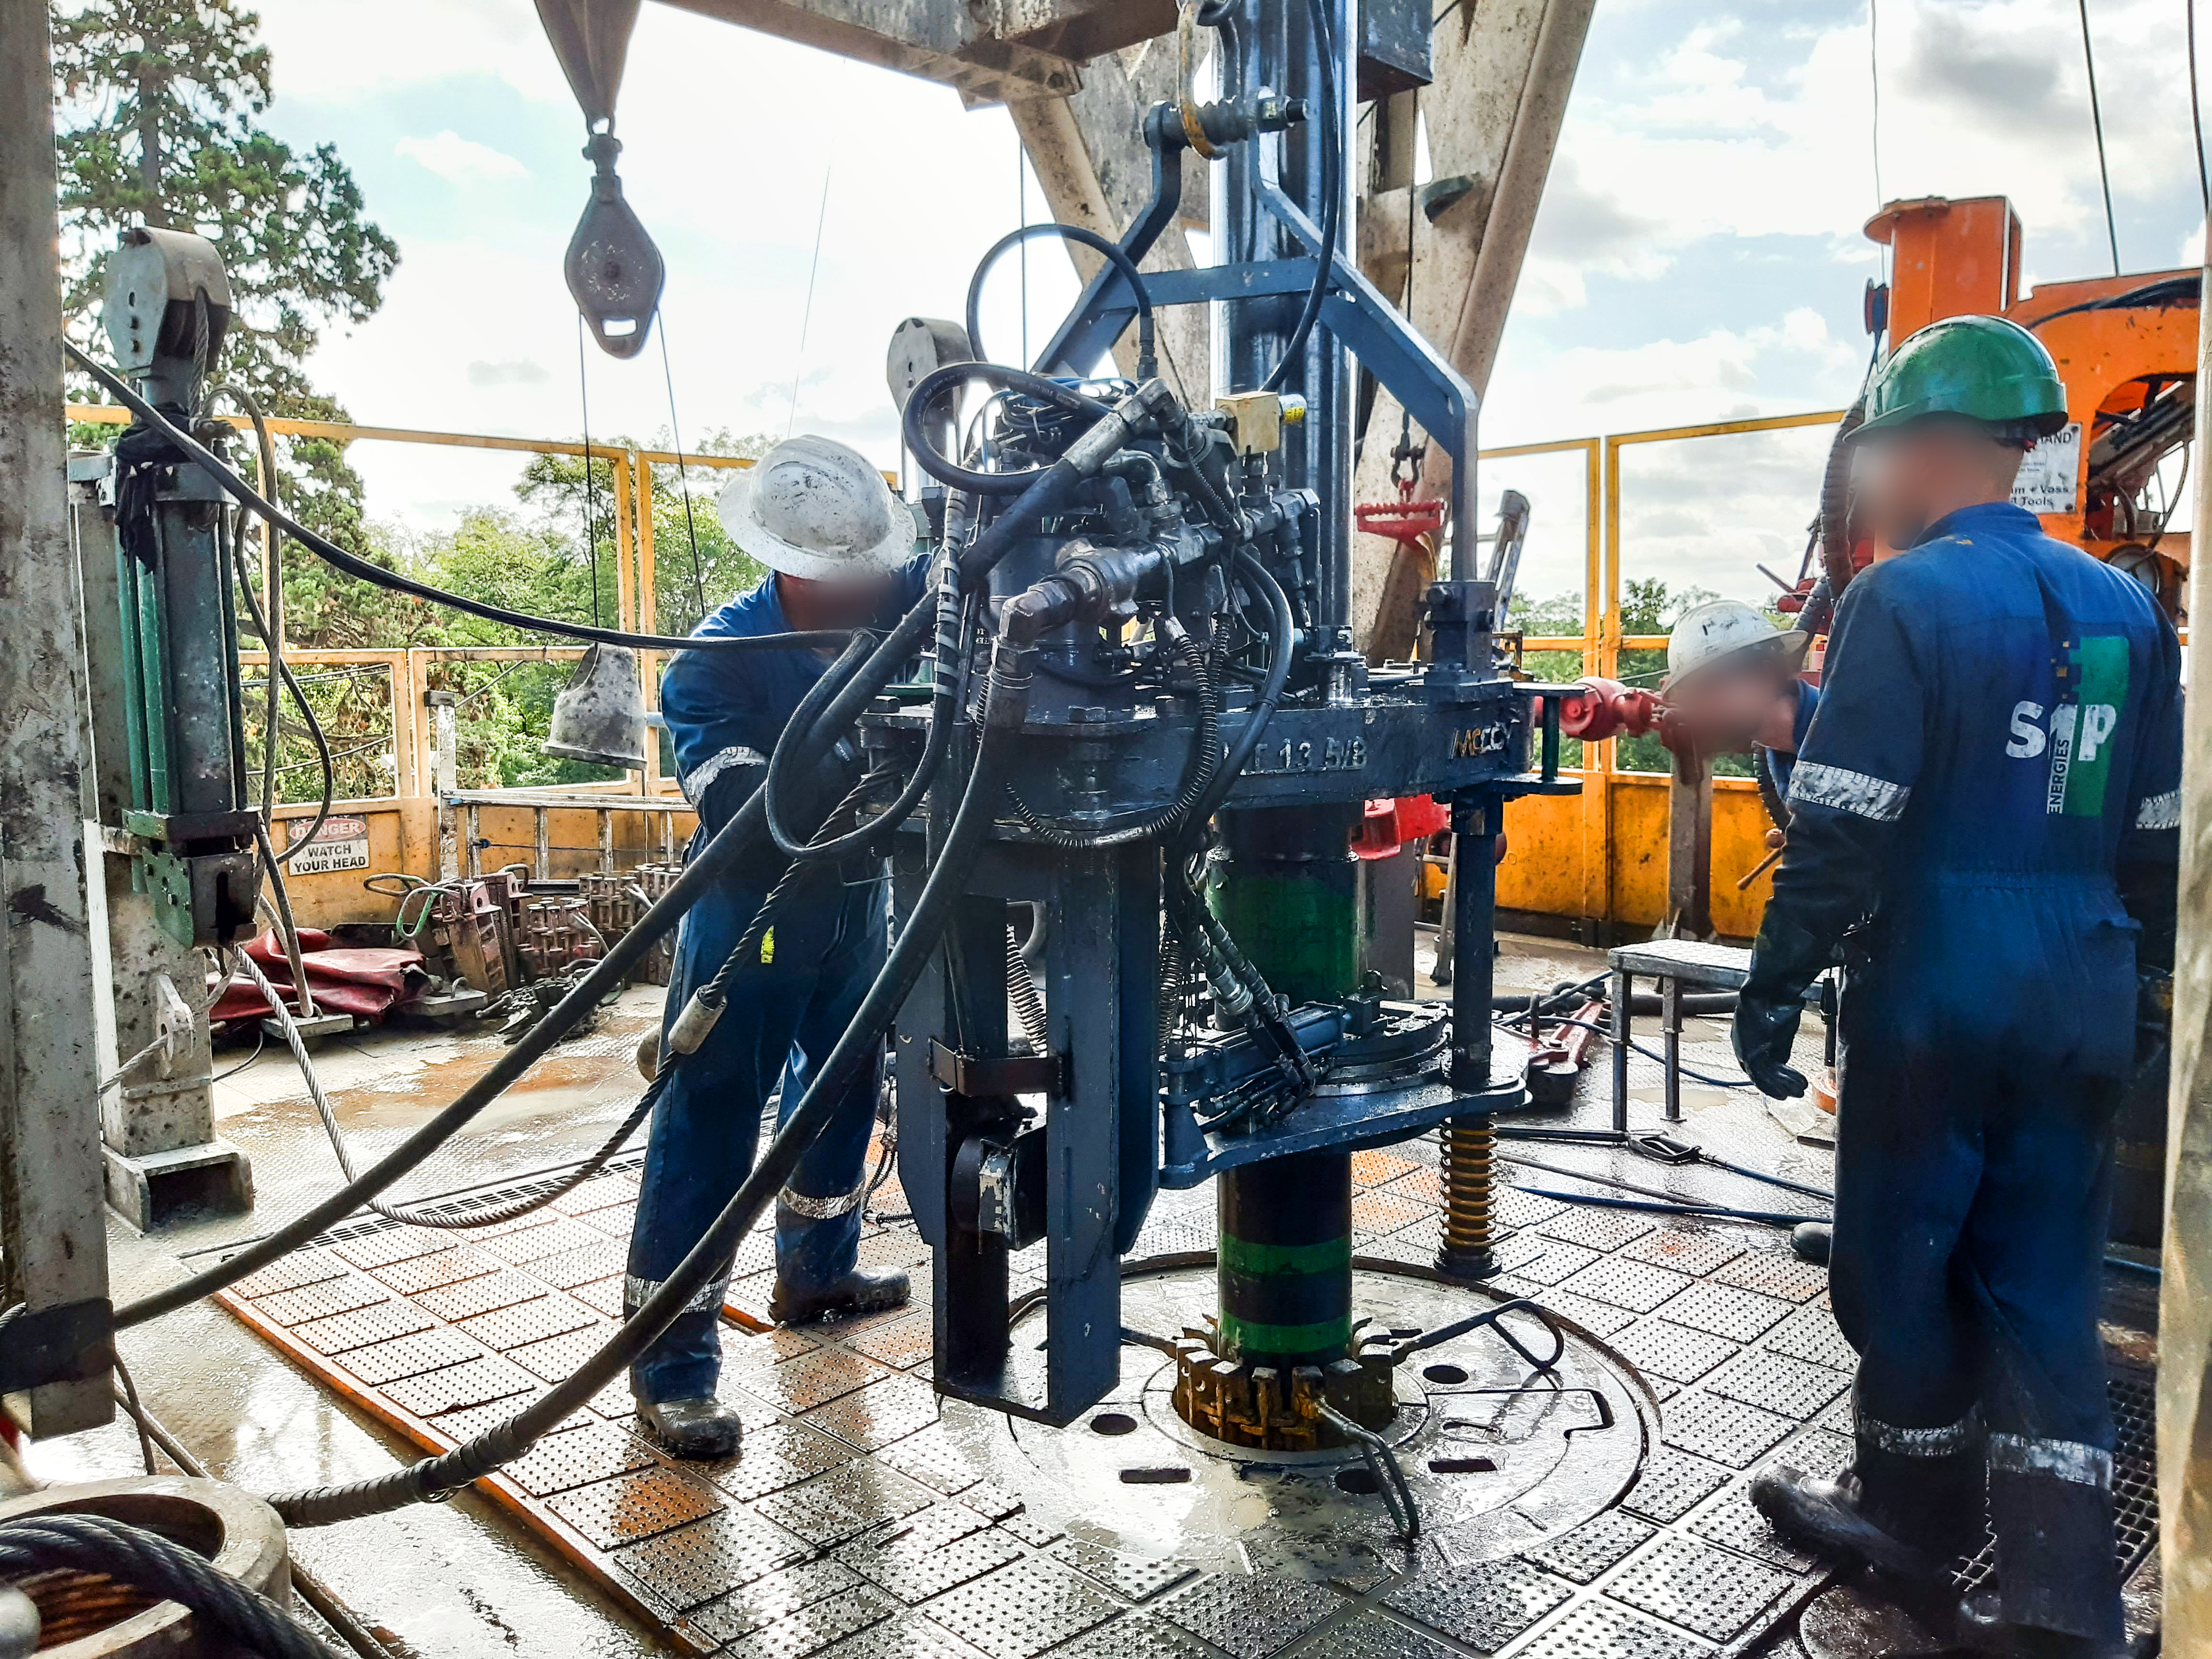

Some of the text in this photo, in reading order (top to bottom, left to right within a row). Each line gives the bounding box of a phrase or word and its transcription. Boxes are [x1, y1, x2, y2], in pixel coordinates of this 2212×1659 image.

[1279, 737, 1314, 769] 13
[2048, 739, 2069, 814] ENERGIES
[295, 821, 360, 838] DNGER
[307, 844, 352, 858] WATCH
[294, 856, 366, 873] YOUR HEAD
